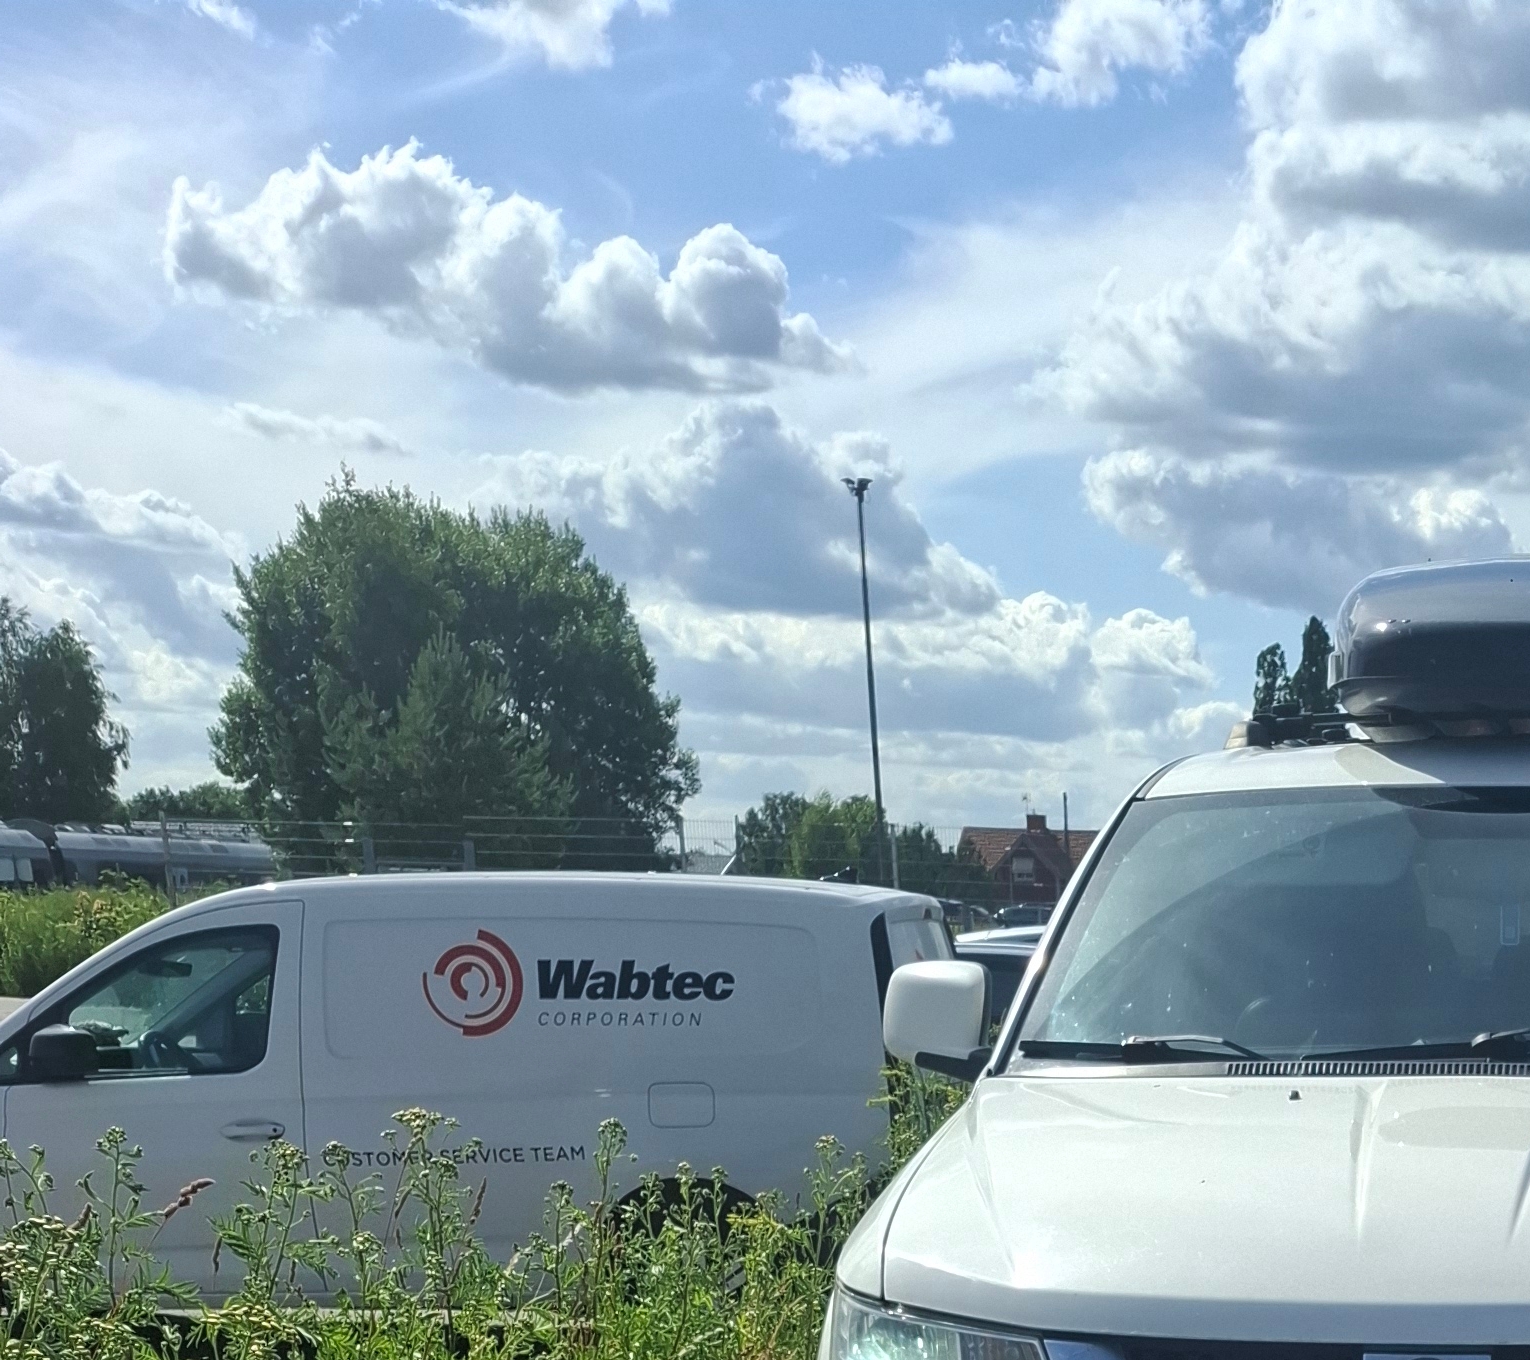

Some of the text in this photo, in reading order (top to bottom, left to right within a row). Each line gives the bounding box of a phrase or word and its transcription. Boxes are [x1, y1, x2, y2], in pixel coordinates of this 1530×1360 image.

[537, 959, 736, 1001] Wabtec
[538, 1011, 702, 1027] CORPORATION
[530, 1145, 586, 1163] TEAM
